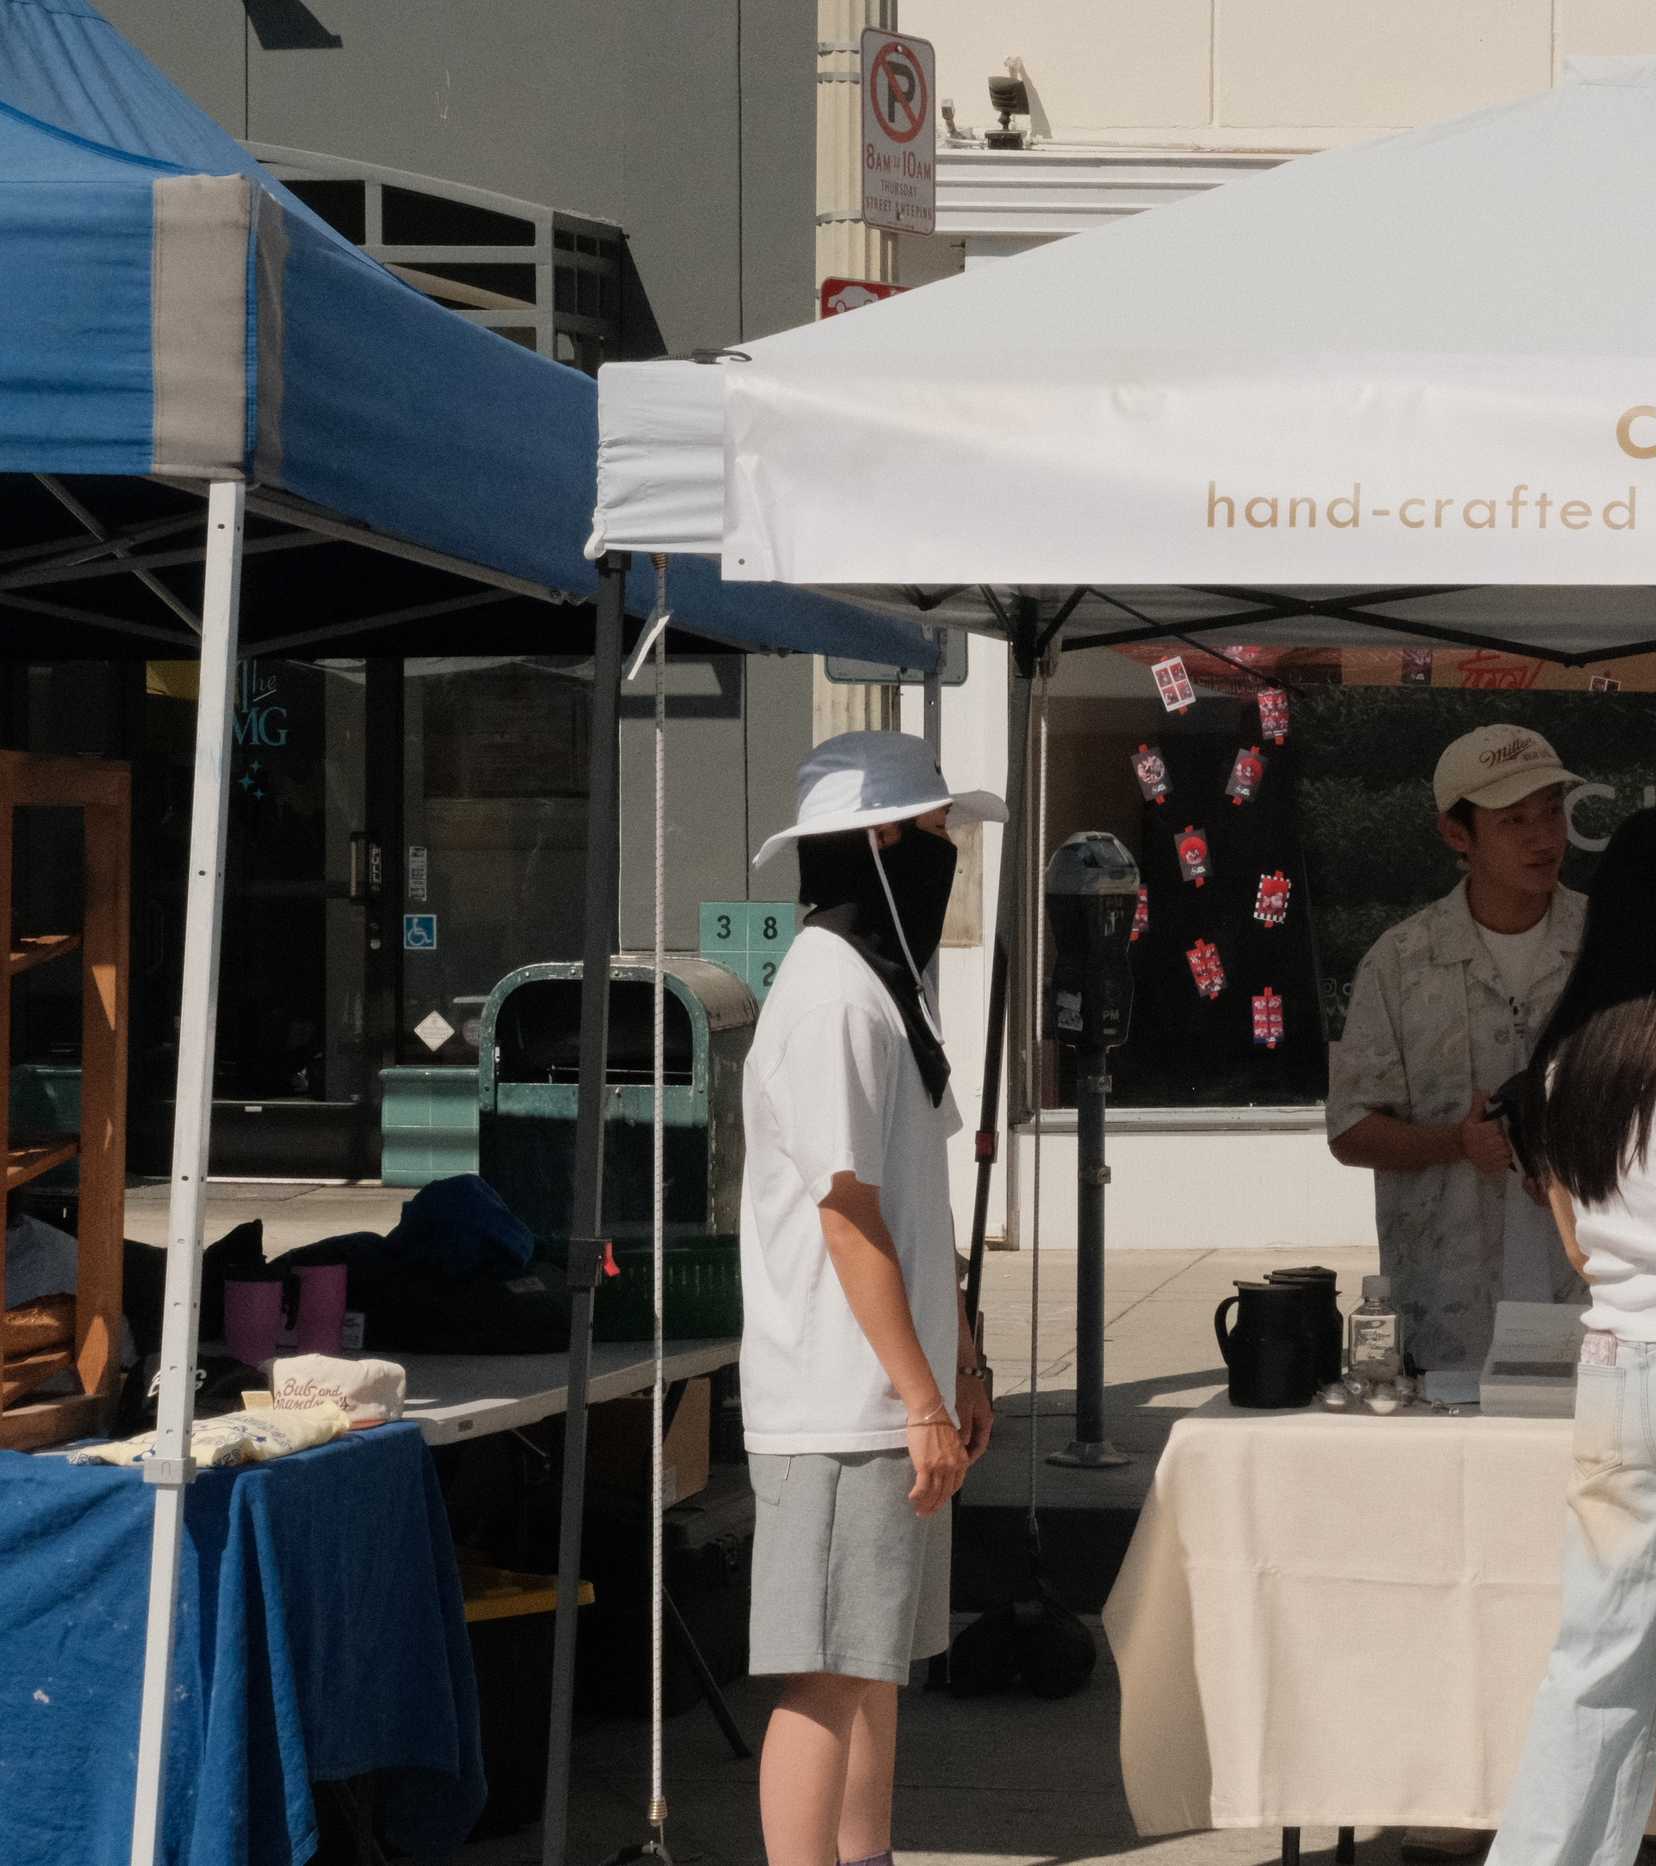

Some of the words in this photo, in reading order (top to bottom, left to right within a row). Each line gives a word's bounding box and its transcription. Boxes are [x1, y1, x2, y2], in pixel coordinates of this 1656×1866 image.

[902, 151, 932, 179] 10AM
[880, 180, 917, 198] THURSDAY
[864, 196, 892, 212] STREET
[1206, 480, 1637, 531] hand-crafted
